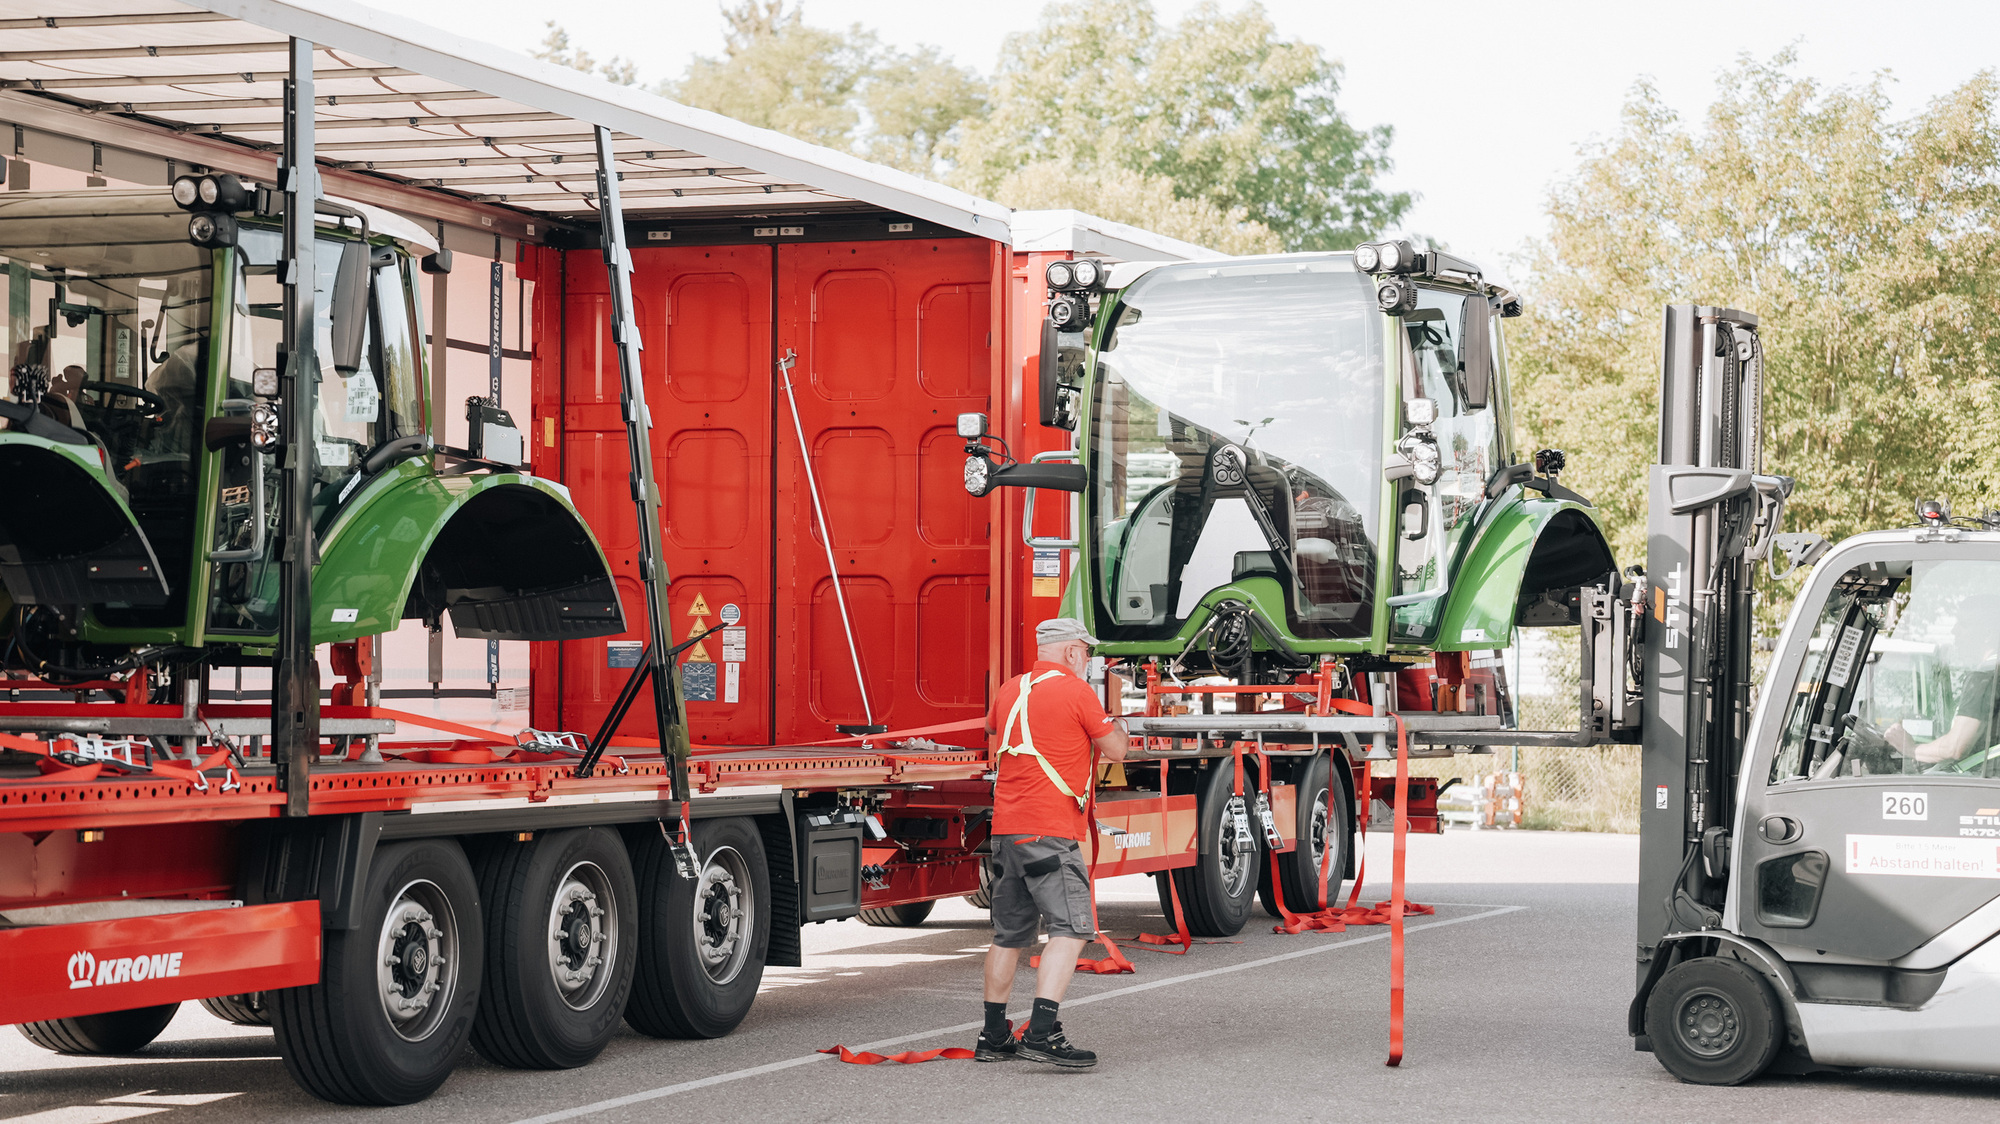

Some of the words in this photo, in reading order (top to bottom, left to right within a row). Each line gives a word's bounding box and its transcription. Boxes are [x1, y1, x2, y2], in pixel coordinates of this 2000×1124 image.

[1665, 562, 1681, 648] STILL
[1885, 796, 1925, 816] 260
[1122, 831, 1151, 849] KRONE
[1869, 856, 1929, 870] Abstand
[1934, 857, 1984, 871] halten!
[95, 952, 183, 986] KRONE
